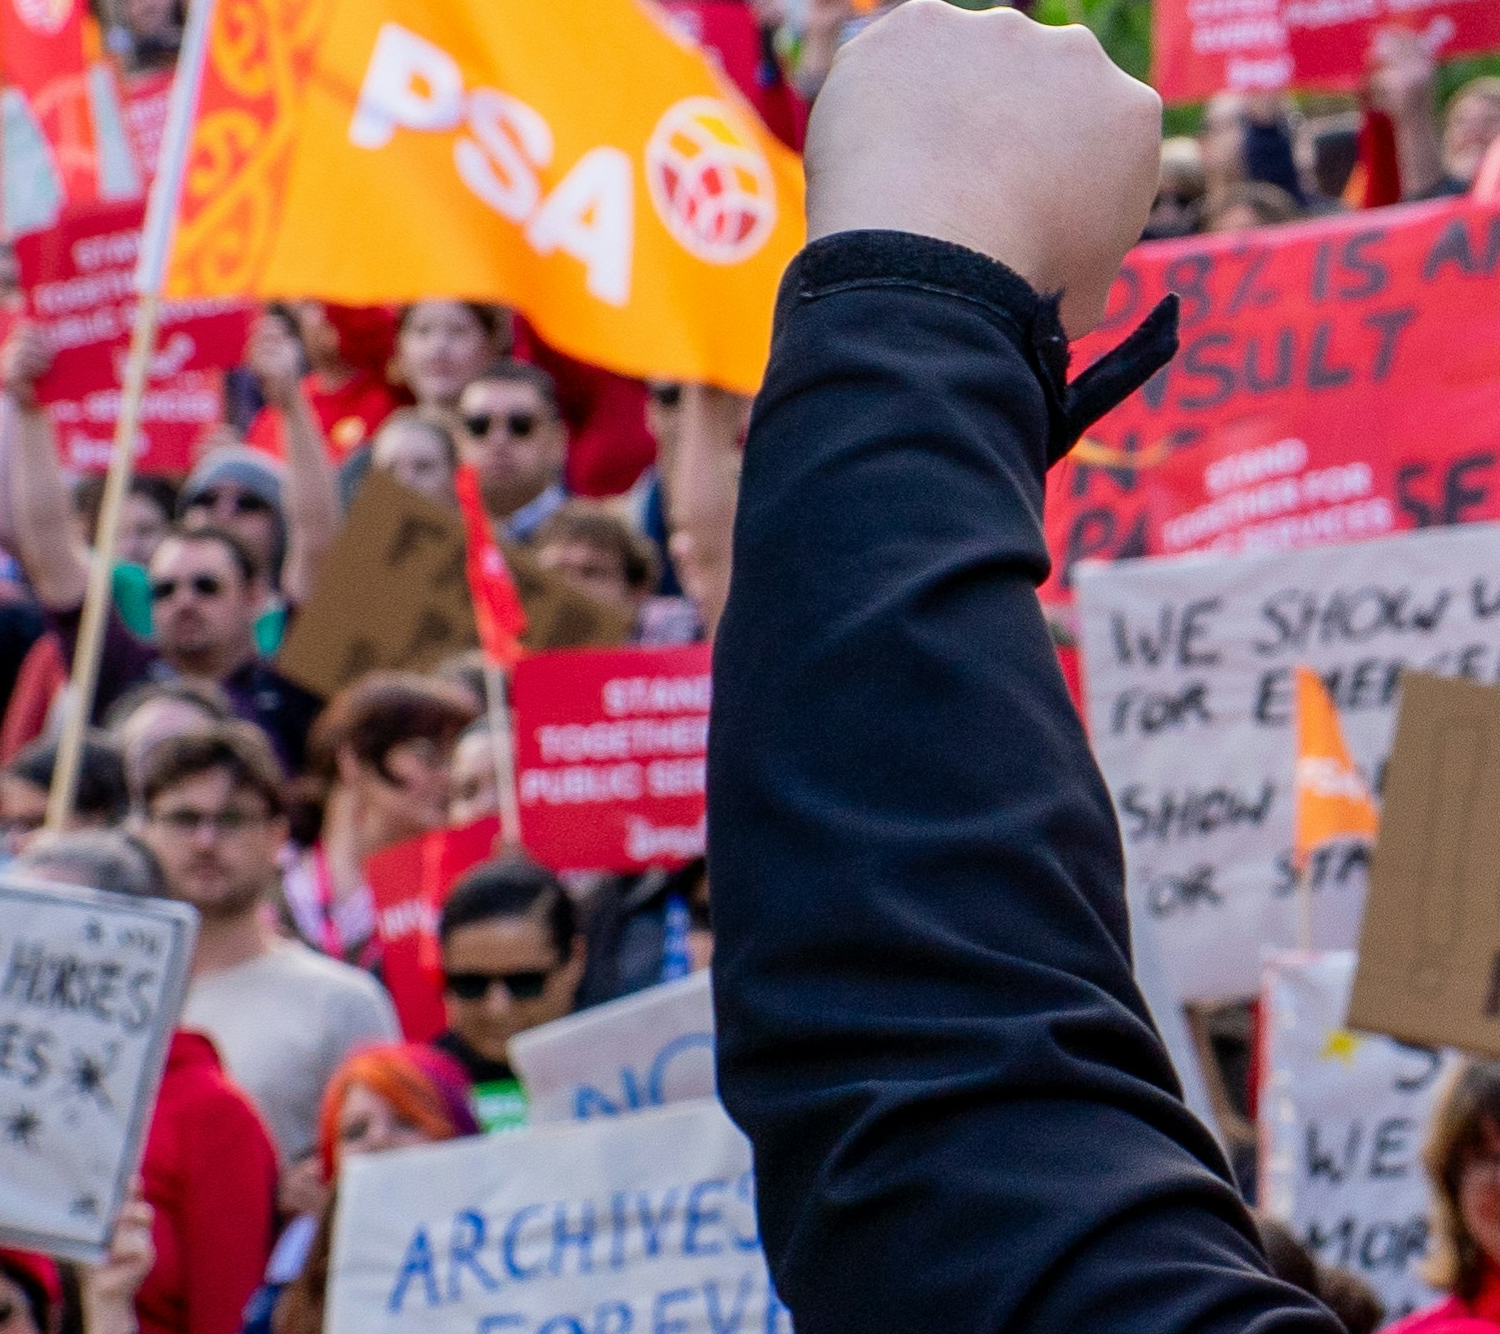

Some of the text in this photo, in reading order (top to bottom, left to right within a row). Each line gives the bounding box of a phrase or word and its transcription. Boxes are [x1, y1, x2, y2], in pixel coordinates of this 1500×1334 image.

[348, 21, 635, 312] PSA
[1309, 228, 1392, 303] IS
[1142, 307, 1417, 413] SULT
[1206, 442, 1306, 494] STAND
[1163, 480, 1300, 550] TOGETHER
[1302, 465, 1373, 503] FOR
[1107, 593, 1221, 669] WE
[1255, 579, 1451, 659] SHOW
[604, 679, 705, 713] STAN
[1111, 685, 1213, 737] FOR
[538, 719, 704, 760] TOGETHE
[520, 763, 641, 801] PUBLIC
[0, 935, 157, 1035] HORSES
[1307, 1117, 1417, 1183] WE
